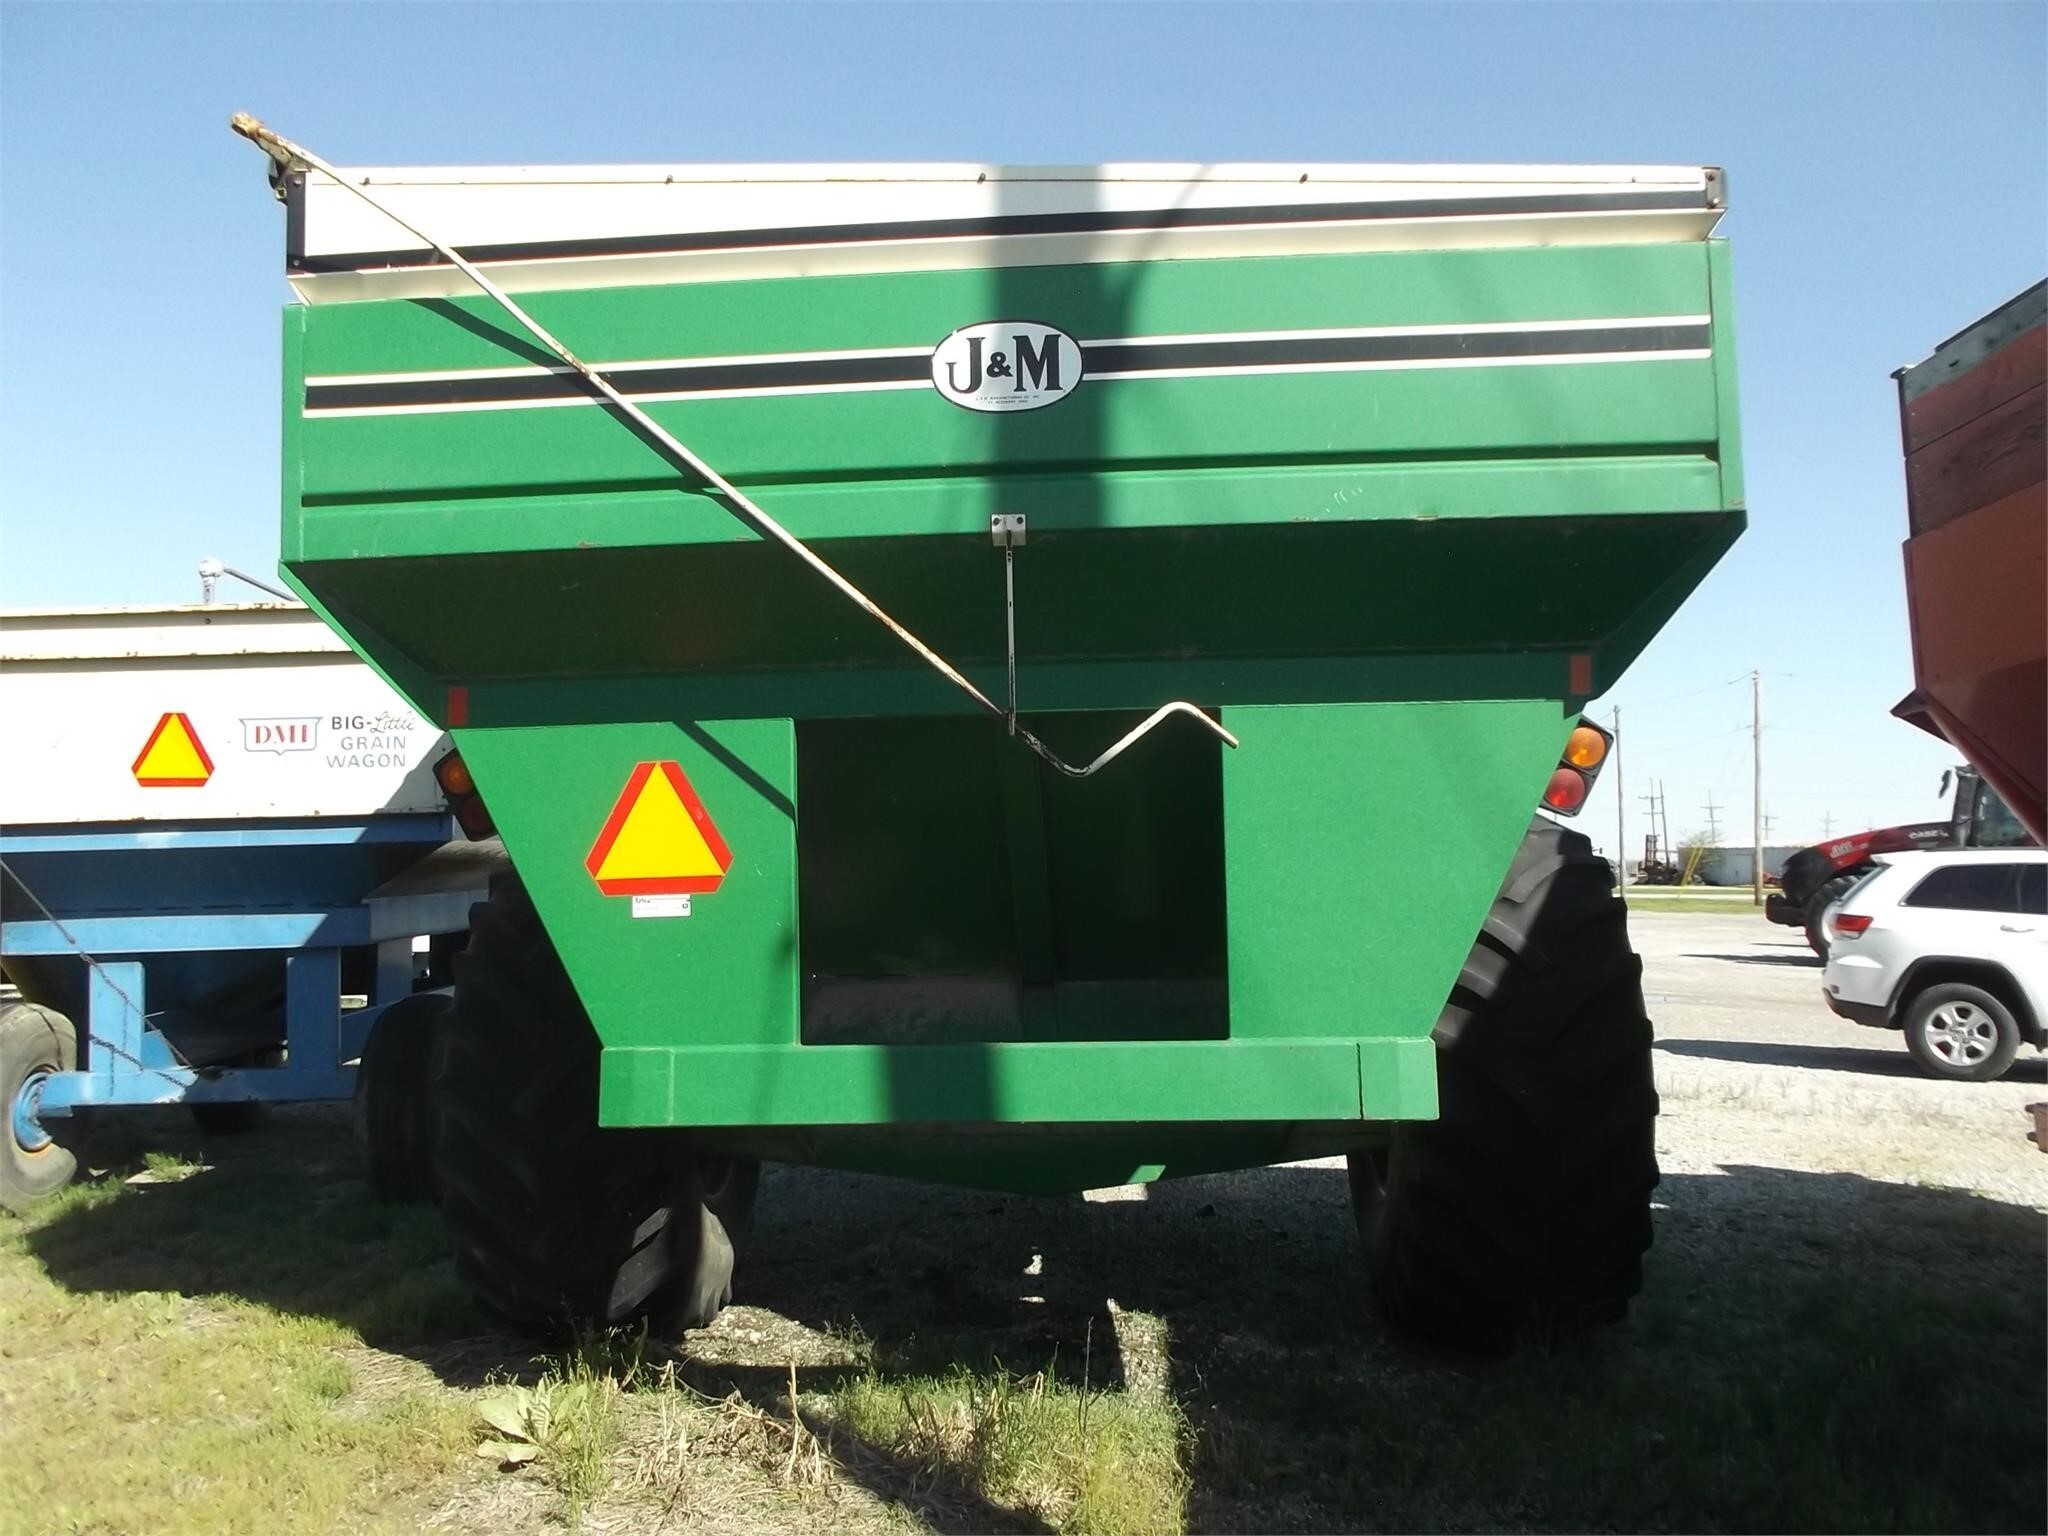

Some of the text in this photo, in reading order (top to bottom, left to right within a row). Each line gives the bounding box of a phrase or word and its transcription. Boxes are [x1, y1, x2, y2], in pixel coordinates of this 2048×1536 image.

[945, 334, 1063, 394] J&M
[254, 724, 308, 744] DMI
[341, 736, 406, 750] GRAIN
[326, 753, 406, 768] WAGON
